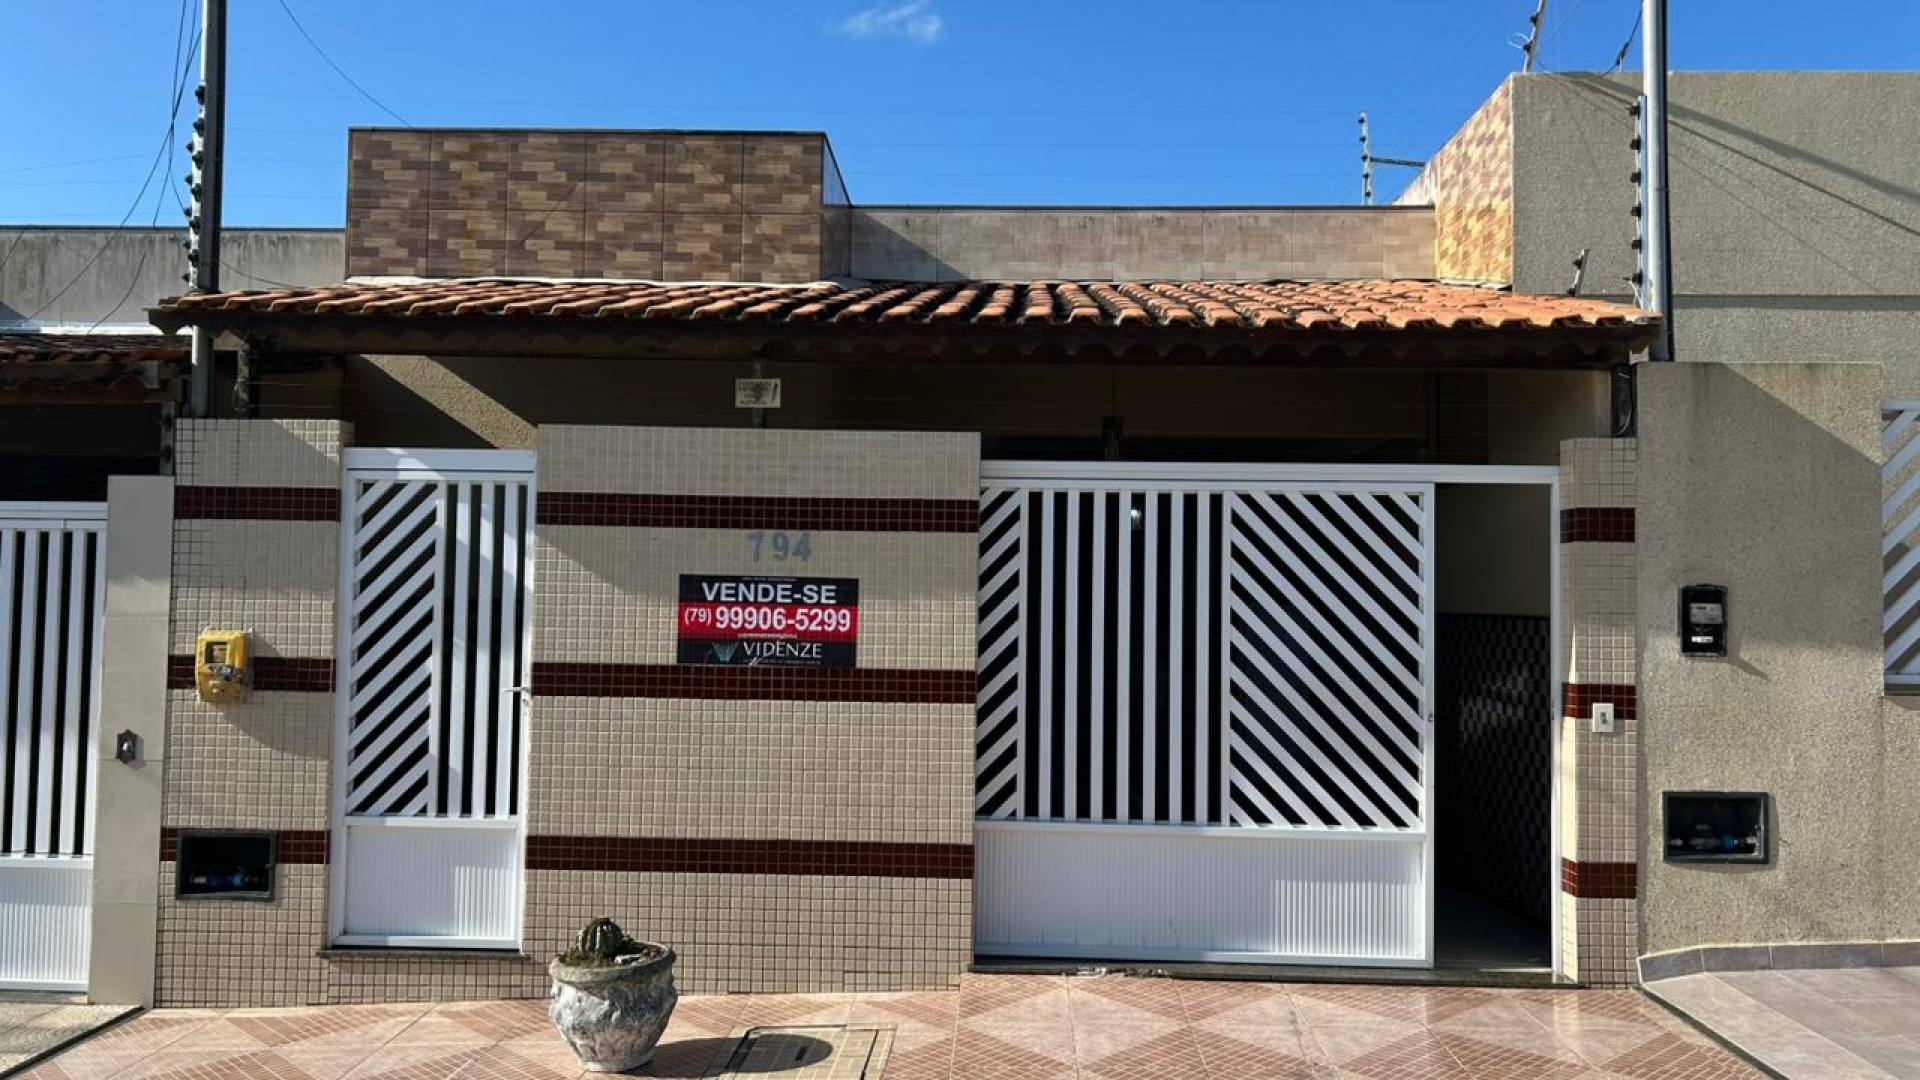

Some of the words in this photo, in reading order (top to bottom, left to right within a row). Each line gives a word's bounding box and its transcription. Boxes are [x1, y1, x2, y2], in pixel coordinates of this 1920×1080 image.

[747, 531, 812, 562] 794
[702, 582, 837, 604] VENDE-SE
[685, 608, 712, 625] (79)
[716, 606, 851, 632] 99906-5299
[743, 641, 822, 658] VIDENZE
